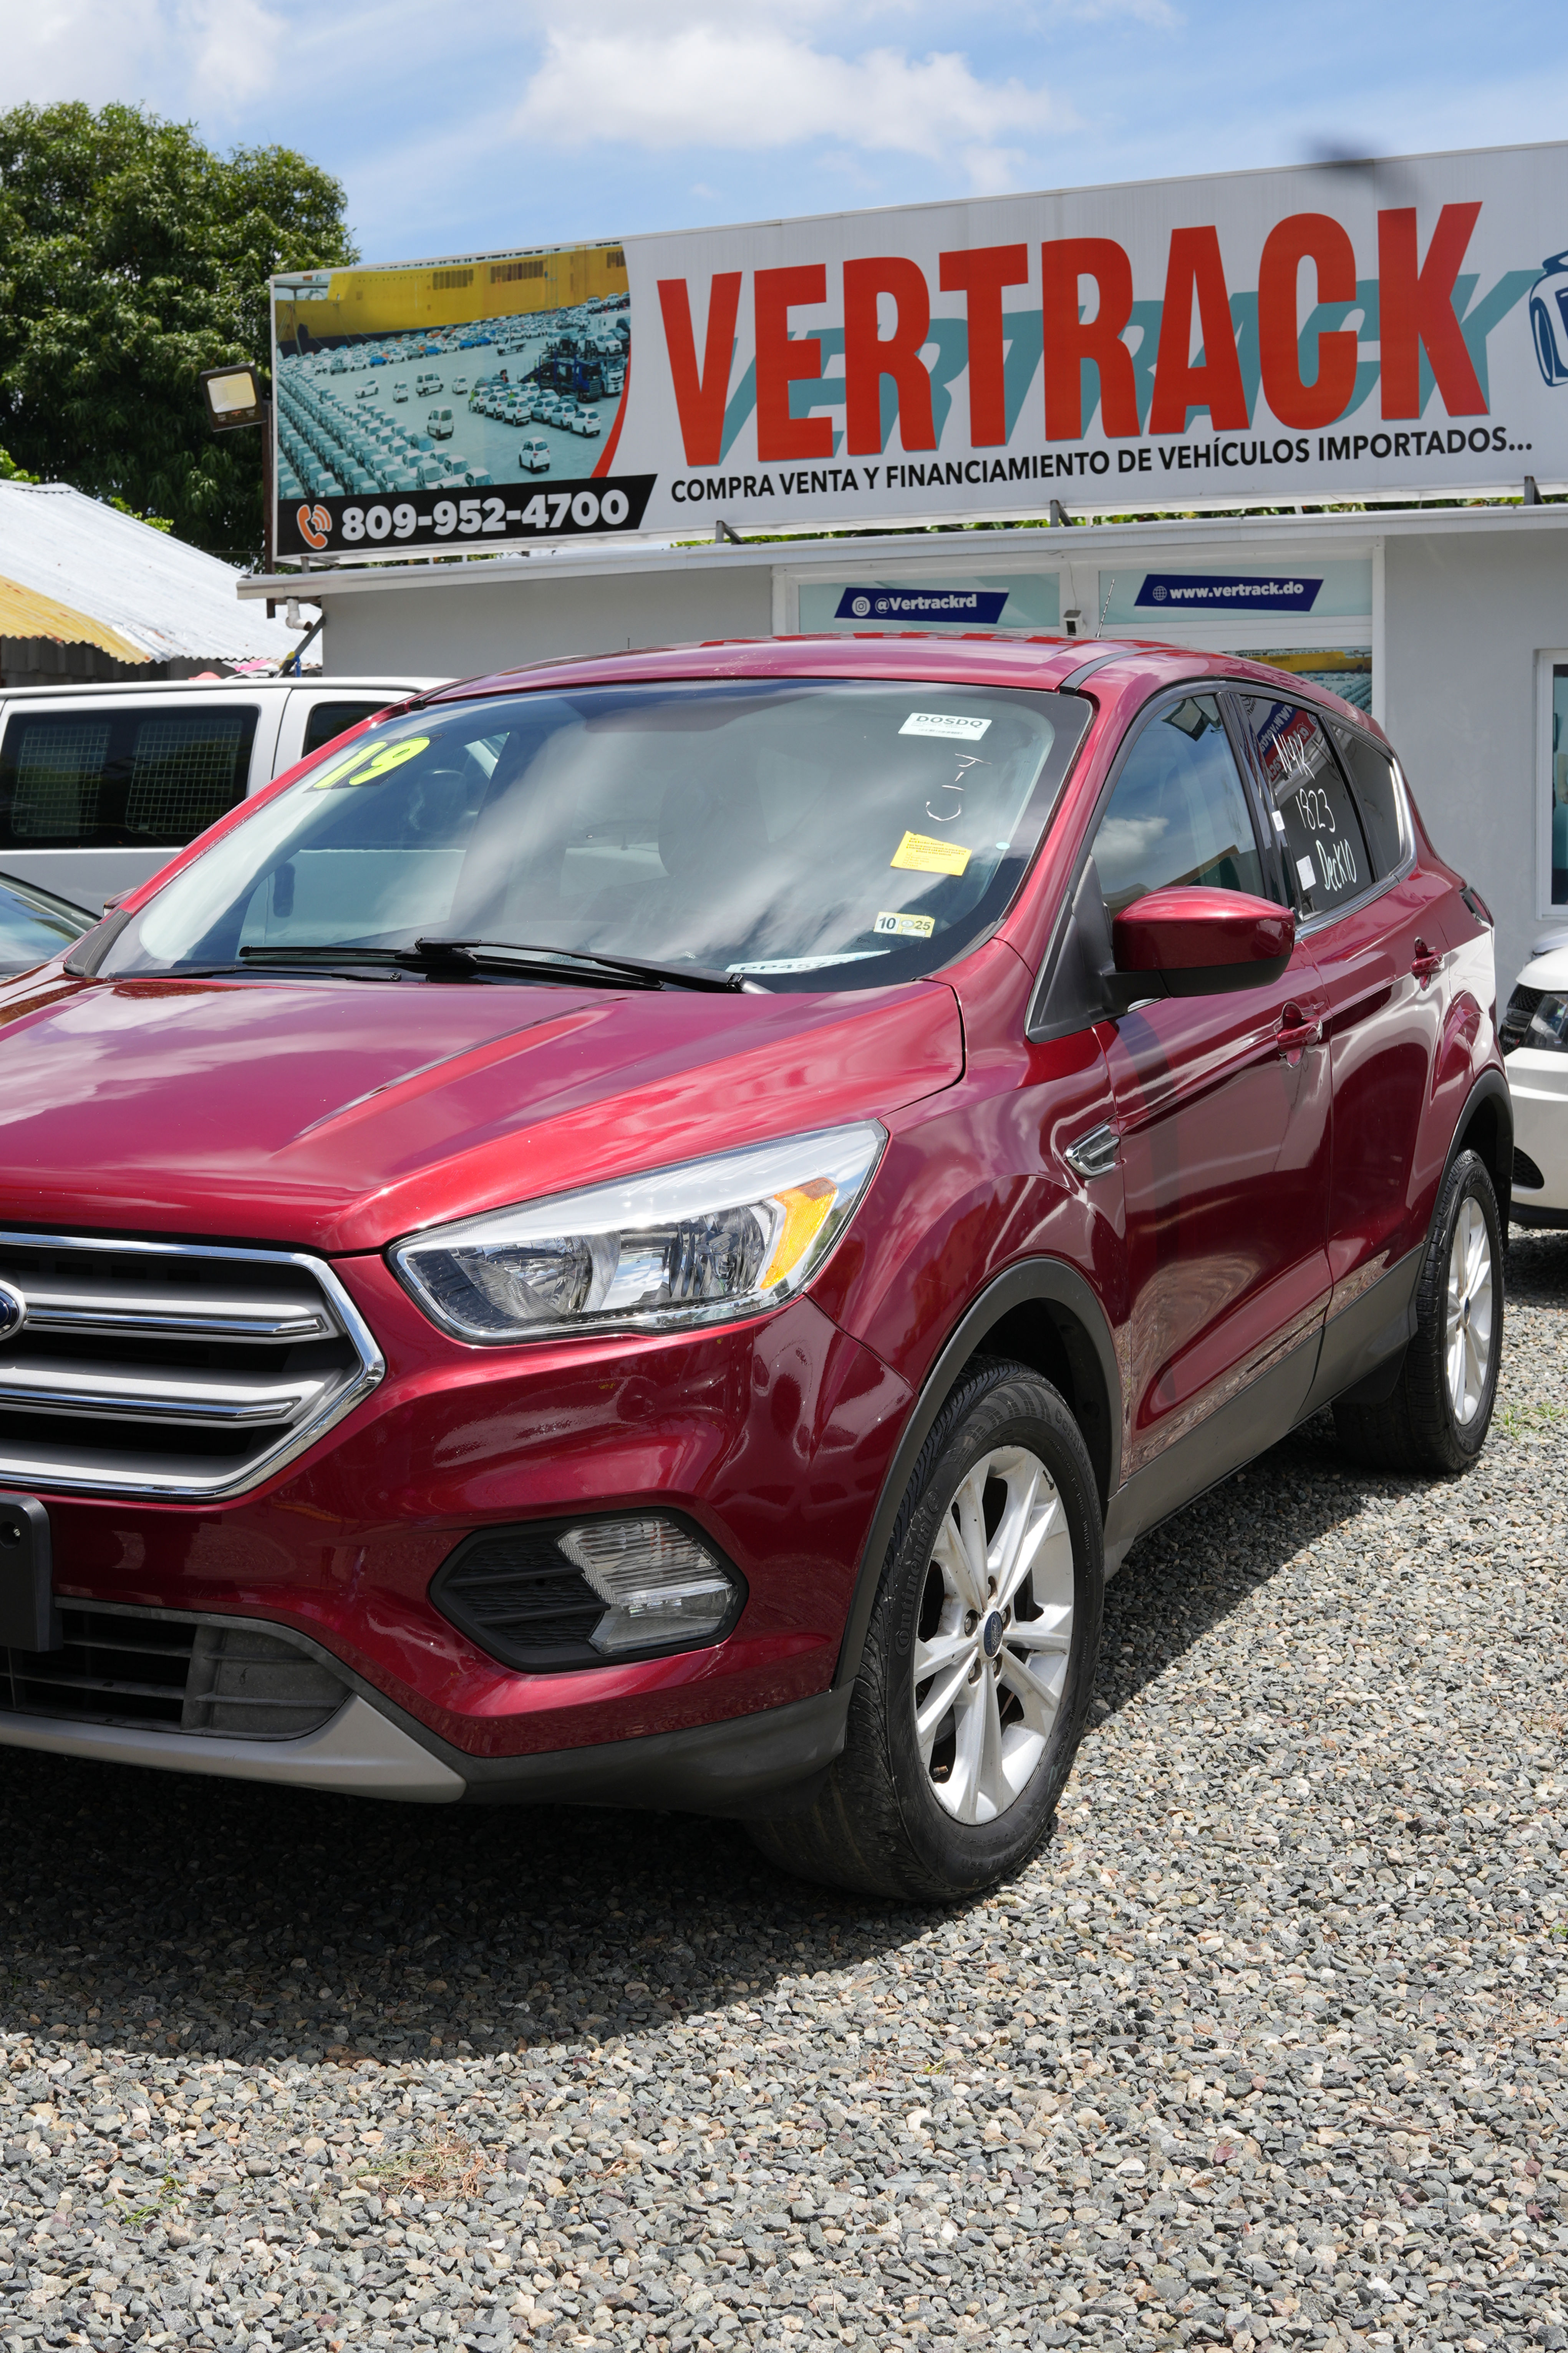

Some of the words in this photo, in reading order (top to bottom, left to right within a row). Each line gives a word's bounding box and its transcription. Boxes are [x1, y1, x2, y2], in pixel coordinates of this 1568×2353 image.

[657, 201, 1489, 466] VERTRACK
[671, 475, 775, 502] COMPRA
[779, 469, 859, 494] VENTA
[863, 467, 880, 490] Y
[886, 451, 1110, 488] FINANCIAMIENTO
[1118, 448, 1152, 473] DE
[1159, 437, 1309, 470] VEHÍCULOS
[1319, 426, 1533, 461] IMPORTADOS...
[342, 490, 629, 541] 809-952-4700
[875, 594, 977, 613] @Vertrackrd
[1170, 581, 1304, 599] www.vertrack.do
[916, 715, 983, 728] DOSDQ
[312, 736, 430, 789] 19
[1295, 788, 1336, 833] 1823
[879, 917, 896, 929] 10
[915, 920, 931, 930] 25
[895, 1507, 934, 1656] Continental
